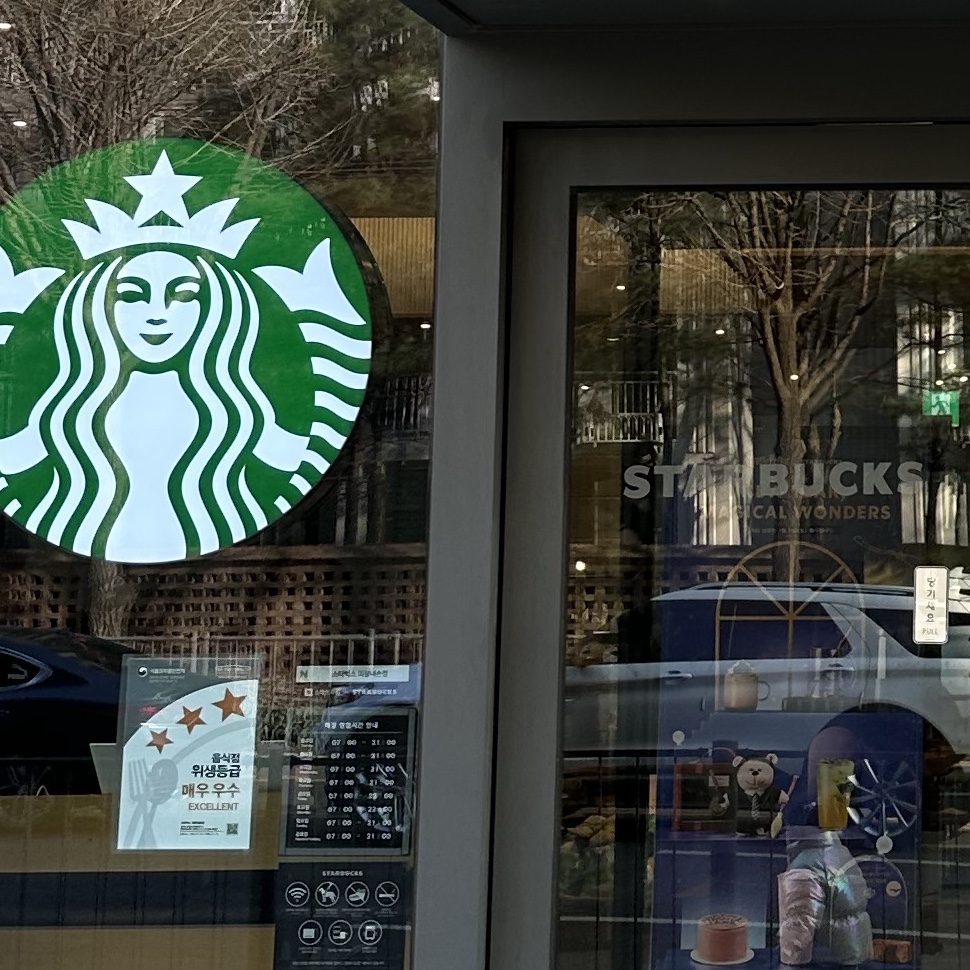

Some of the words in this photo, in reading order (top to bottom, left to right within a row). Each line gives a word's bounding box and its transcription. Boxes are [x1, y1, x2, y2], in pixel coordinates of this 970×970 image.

[795, 505, 892, 520] WONDERS
[925, 576, 936, 623] 당기세요
[922, 627, 938, 636] PULL
[211, 753, 241, 764] 음식점
[191, 764, 242, 779] 위생등급
[181, 782, 210, 799] 매우
[211, 782, 241, 799] 우수
[188, 802, 240, 811] EXCELLENT
